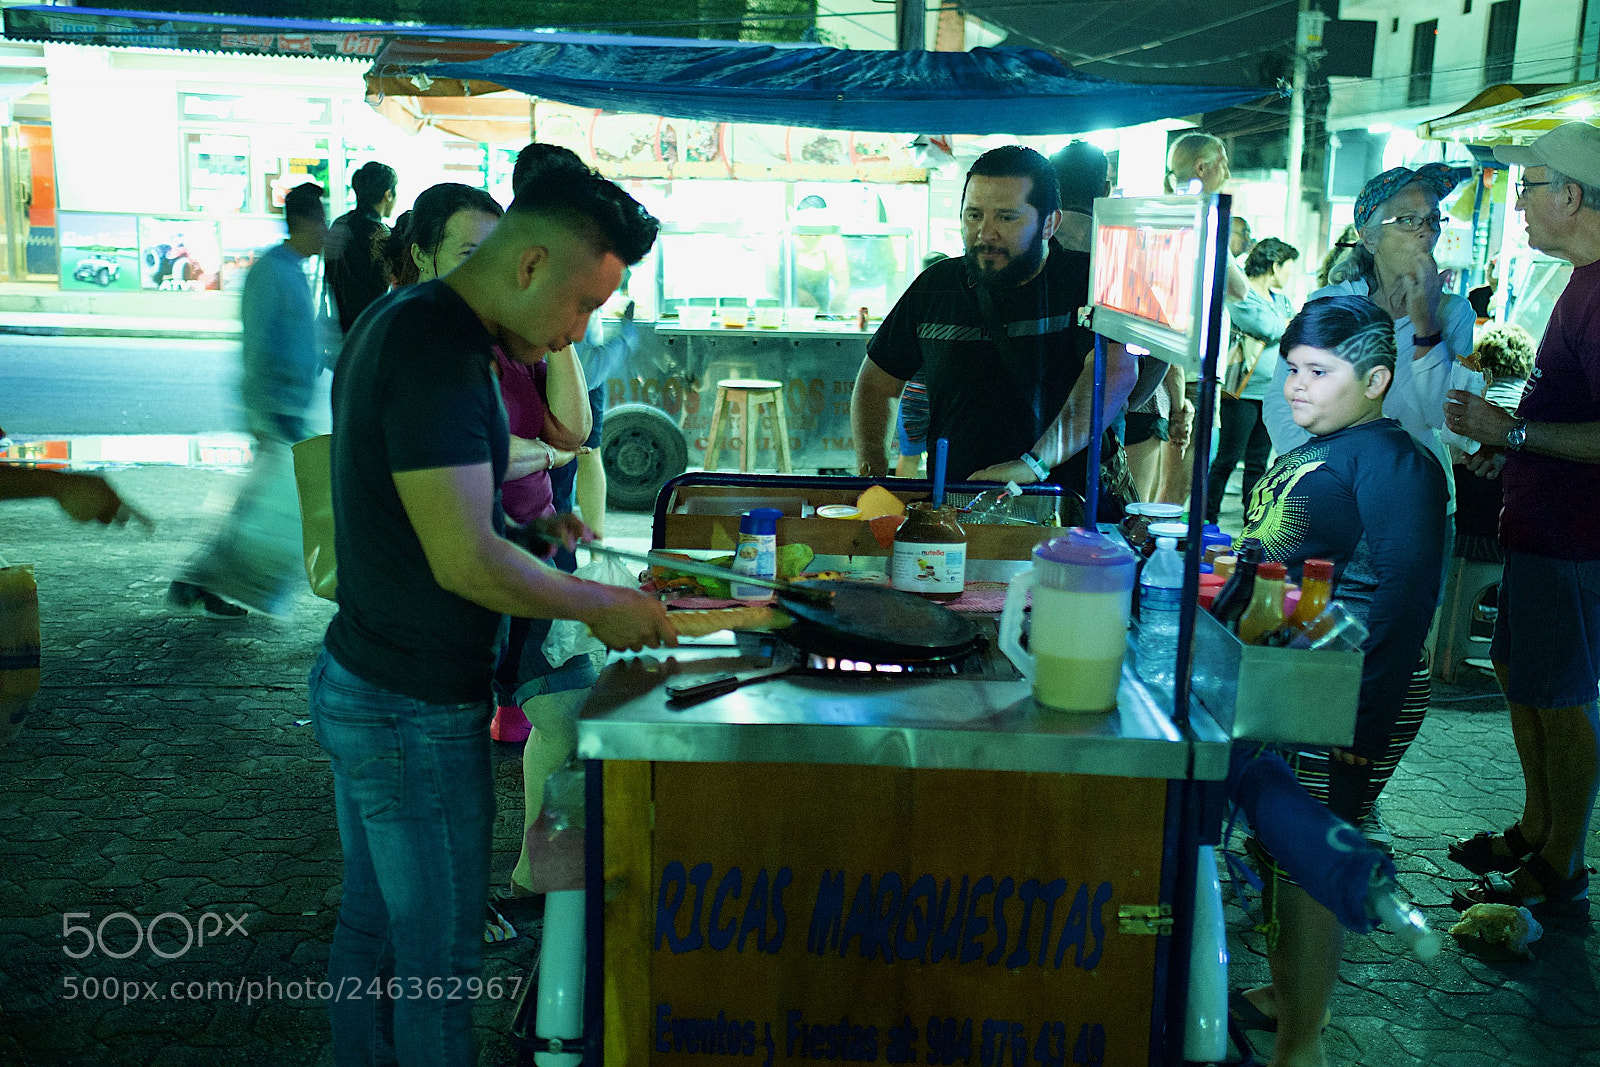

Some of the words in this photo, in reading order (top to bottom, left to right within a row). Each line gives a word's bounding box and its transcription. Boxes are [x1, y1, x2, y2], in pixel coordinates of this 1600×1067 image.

[343, 32, 384, 56] Car
[606, 377, 701, 415] RICOS
[921, 549, 945, 557] nutella
[653, 860, 793, 955] RICAS
[806, 868, 1113, 971] MARQUESITAS
[655, 1002, 756, 1056] Eventos
